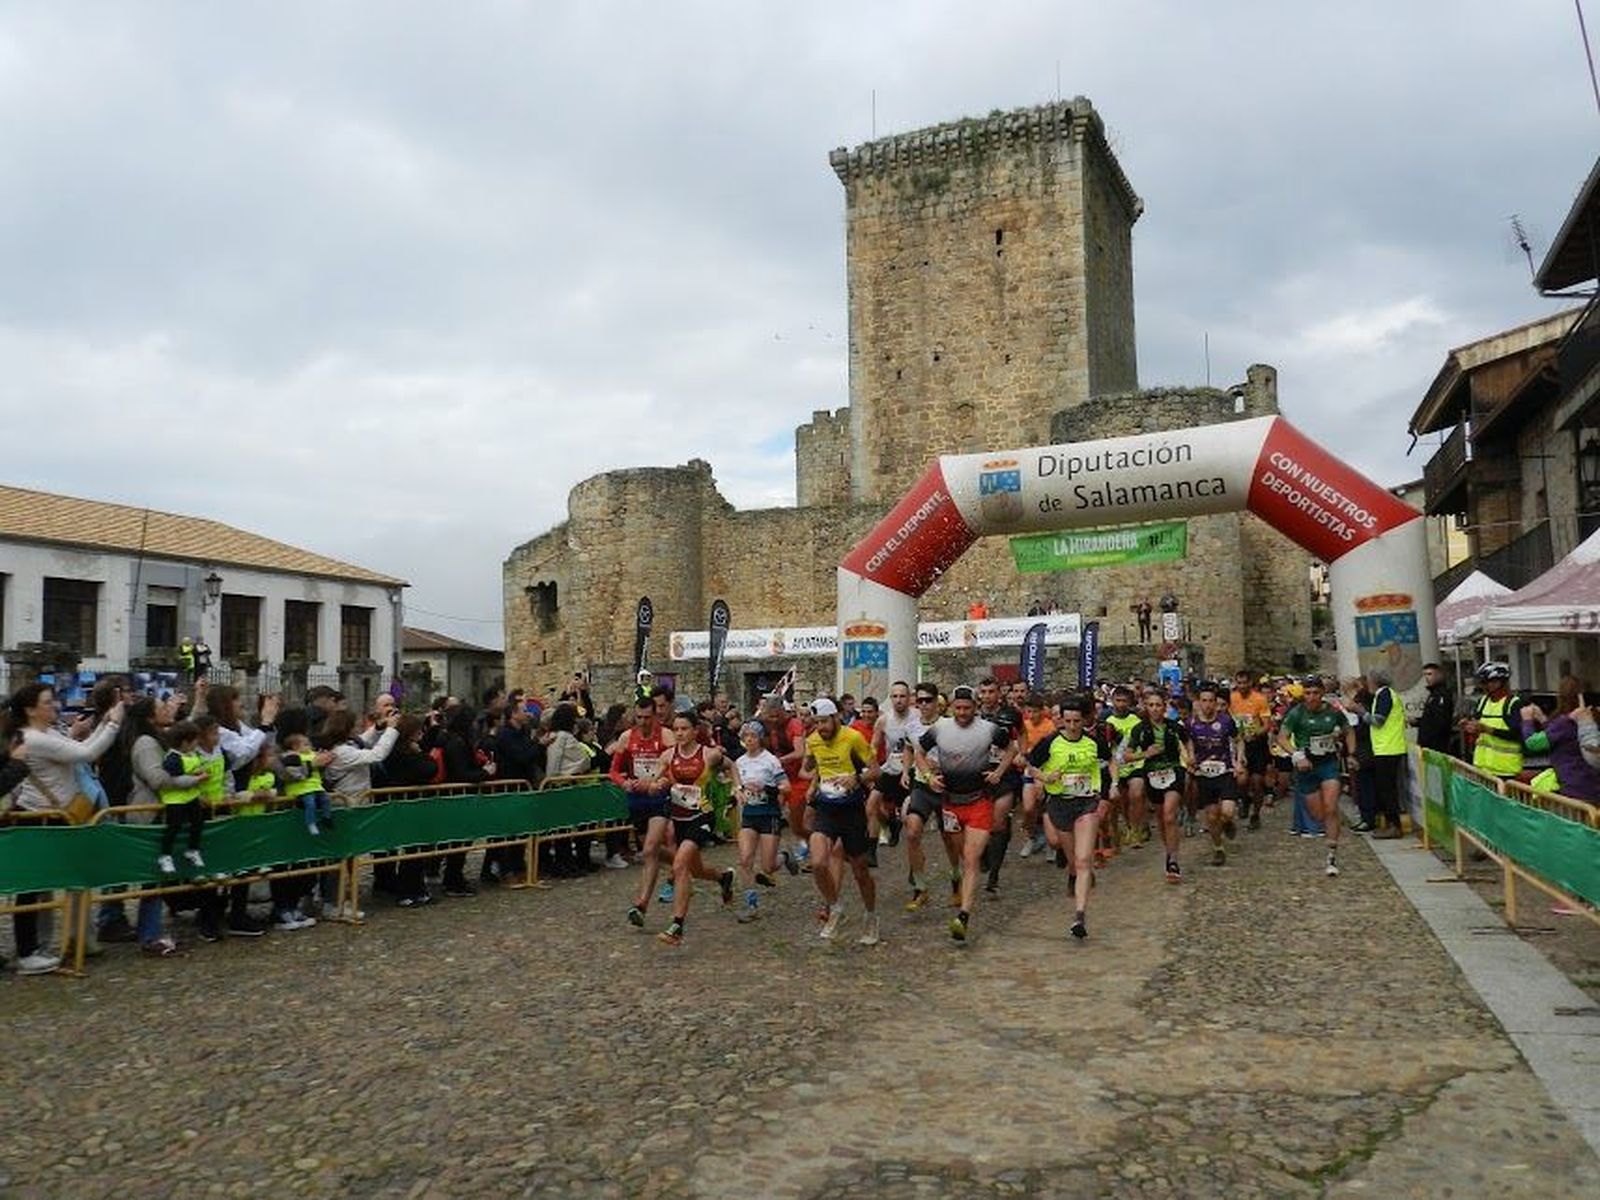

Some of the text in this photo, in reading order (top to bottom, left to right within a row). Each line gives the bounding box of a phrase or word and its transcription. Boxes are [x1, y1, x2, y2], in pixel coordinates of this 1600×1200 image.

[1037, 441, 1193, 481] Diputación
[1037, 475, 1227, 514] de Salamanca
[1261, 471, 1356, 541] DEPORTISTAS
[1269, 452, 1377, 529] CON NUESTROS
[865, 490, 943, 572] CON EL DEPORTE
[1053, 539, 1068, 556] LA
[918, 627, 950, 647] STAÑAR
